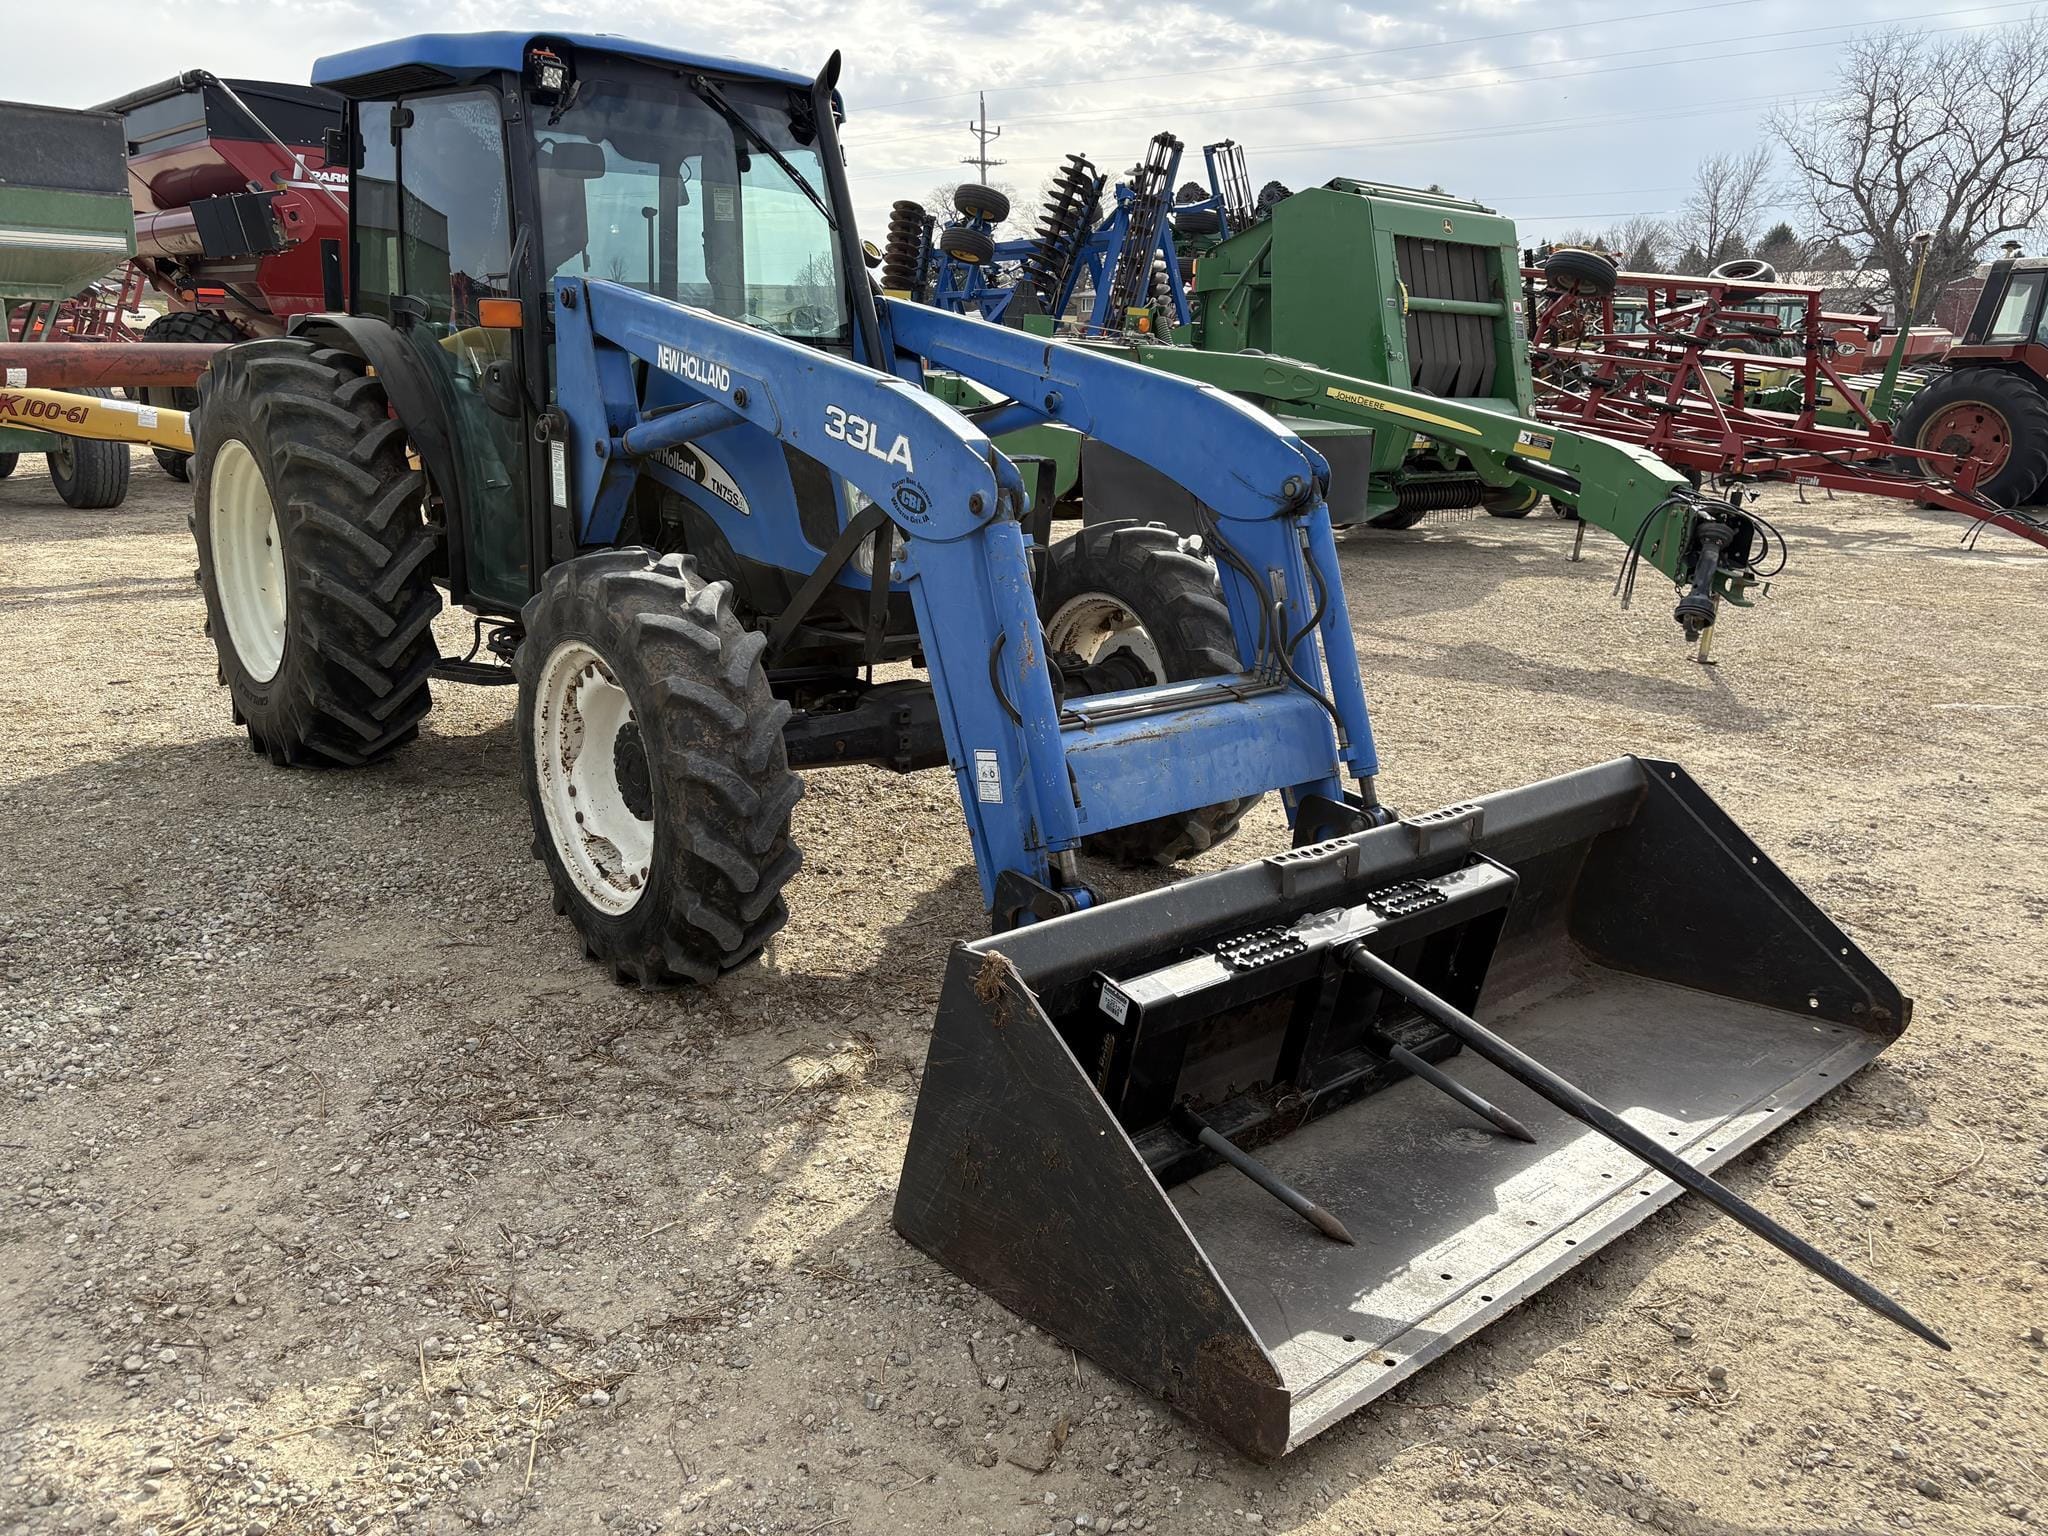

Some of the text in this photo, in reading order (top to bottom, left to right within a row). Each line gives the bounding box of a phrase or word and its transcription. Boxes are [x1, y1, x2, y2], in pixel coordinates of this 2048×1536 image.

[657, 344, 730, 392] NEW HOLLAND
[22, 398, 89, 424] 100-61
[1335, 391, 1385, 410] JOHN DEERE
[824, 404, 914, 474] 33LA
[662, 447, 696, 480] Holland
[901, 490, 922, 512] CBI
